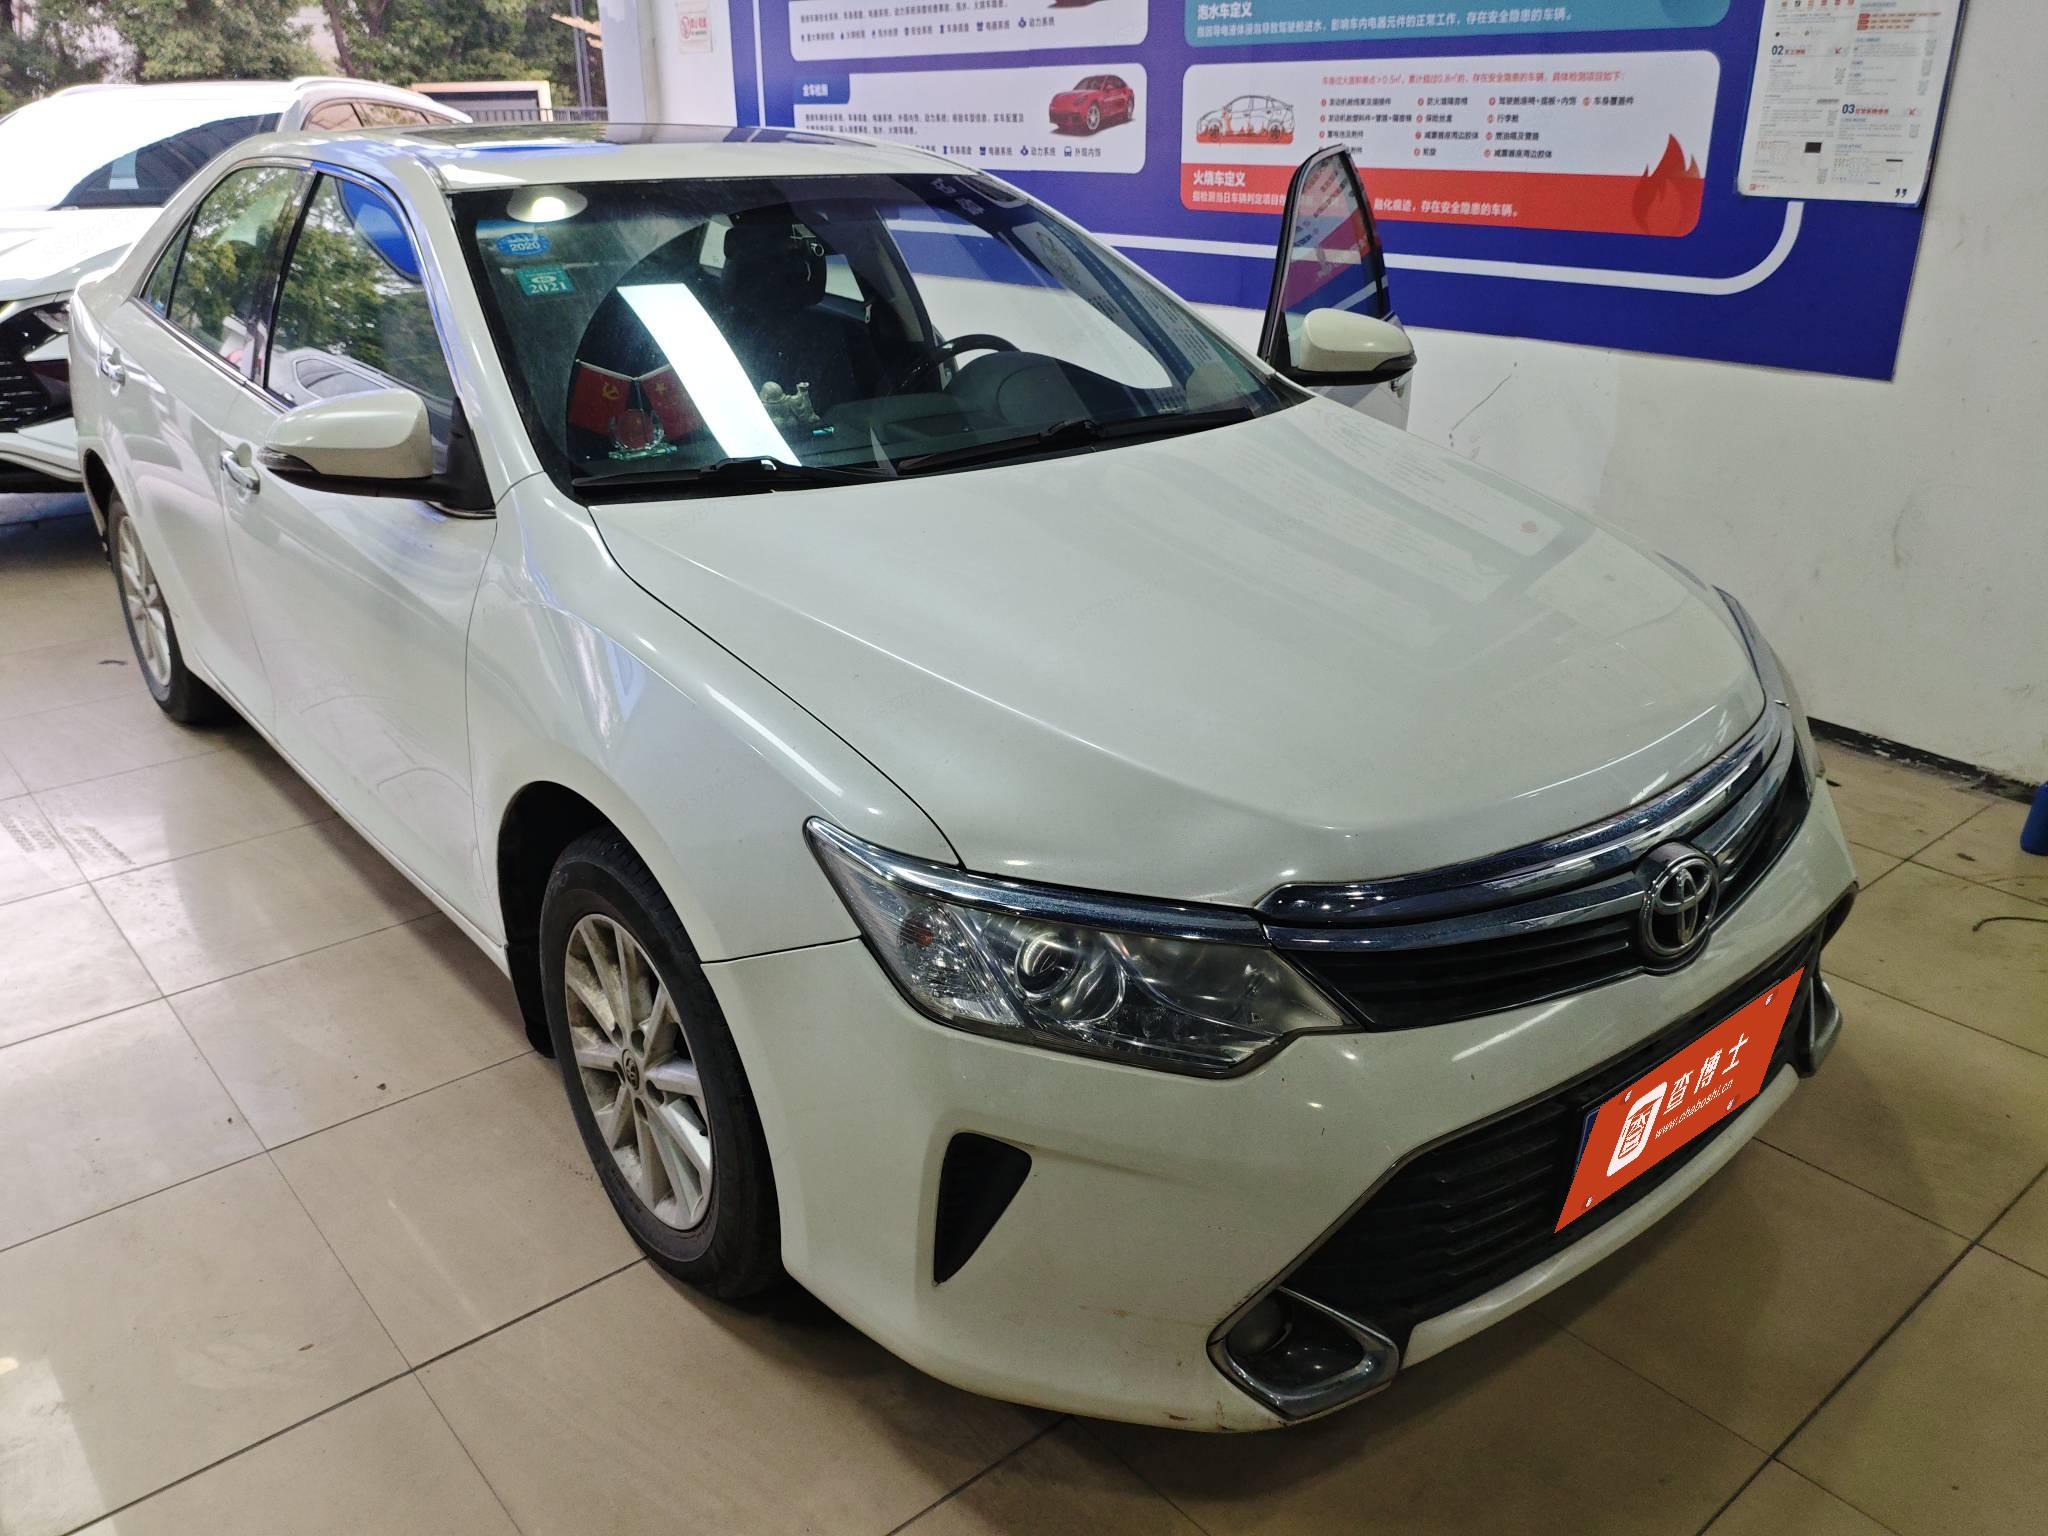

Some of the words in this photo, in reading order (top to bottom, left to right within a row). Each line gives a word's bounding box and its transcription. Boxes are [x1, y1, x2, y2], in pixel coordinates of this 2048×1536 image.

[1771, 45, 1784, 56] 02
[1842, 104, 1856, 114] 03
[1193, 169, 1246, 187] 火烧车定义
[510, 241, 541, 252] 2020
[528, 281, 568, 294] 2021
